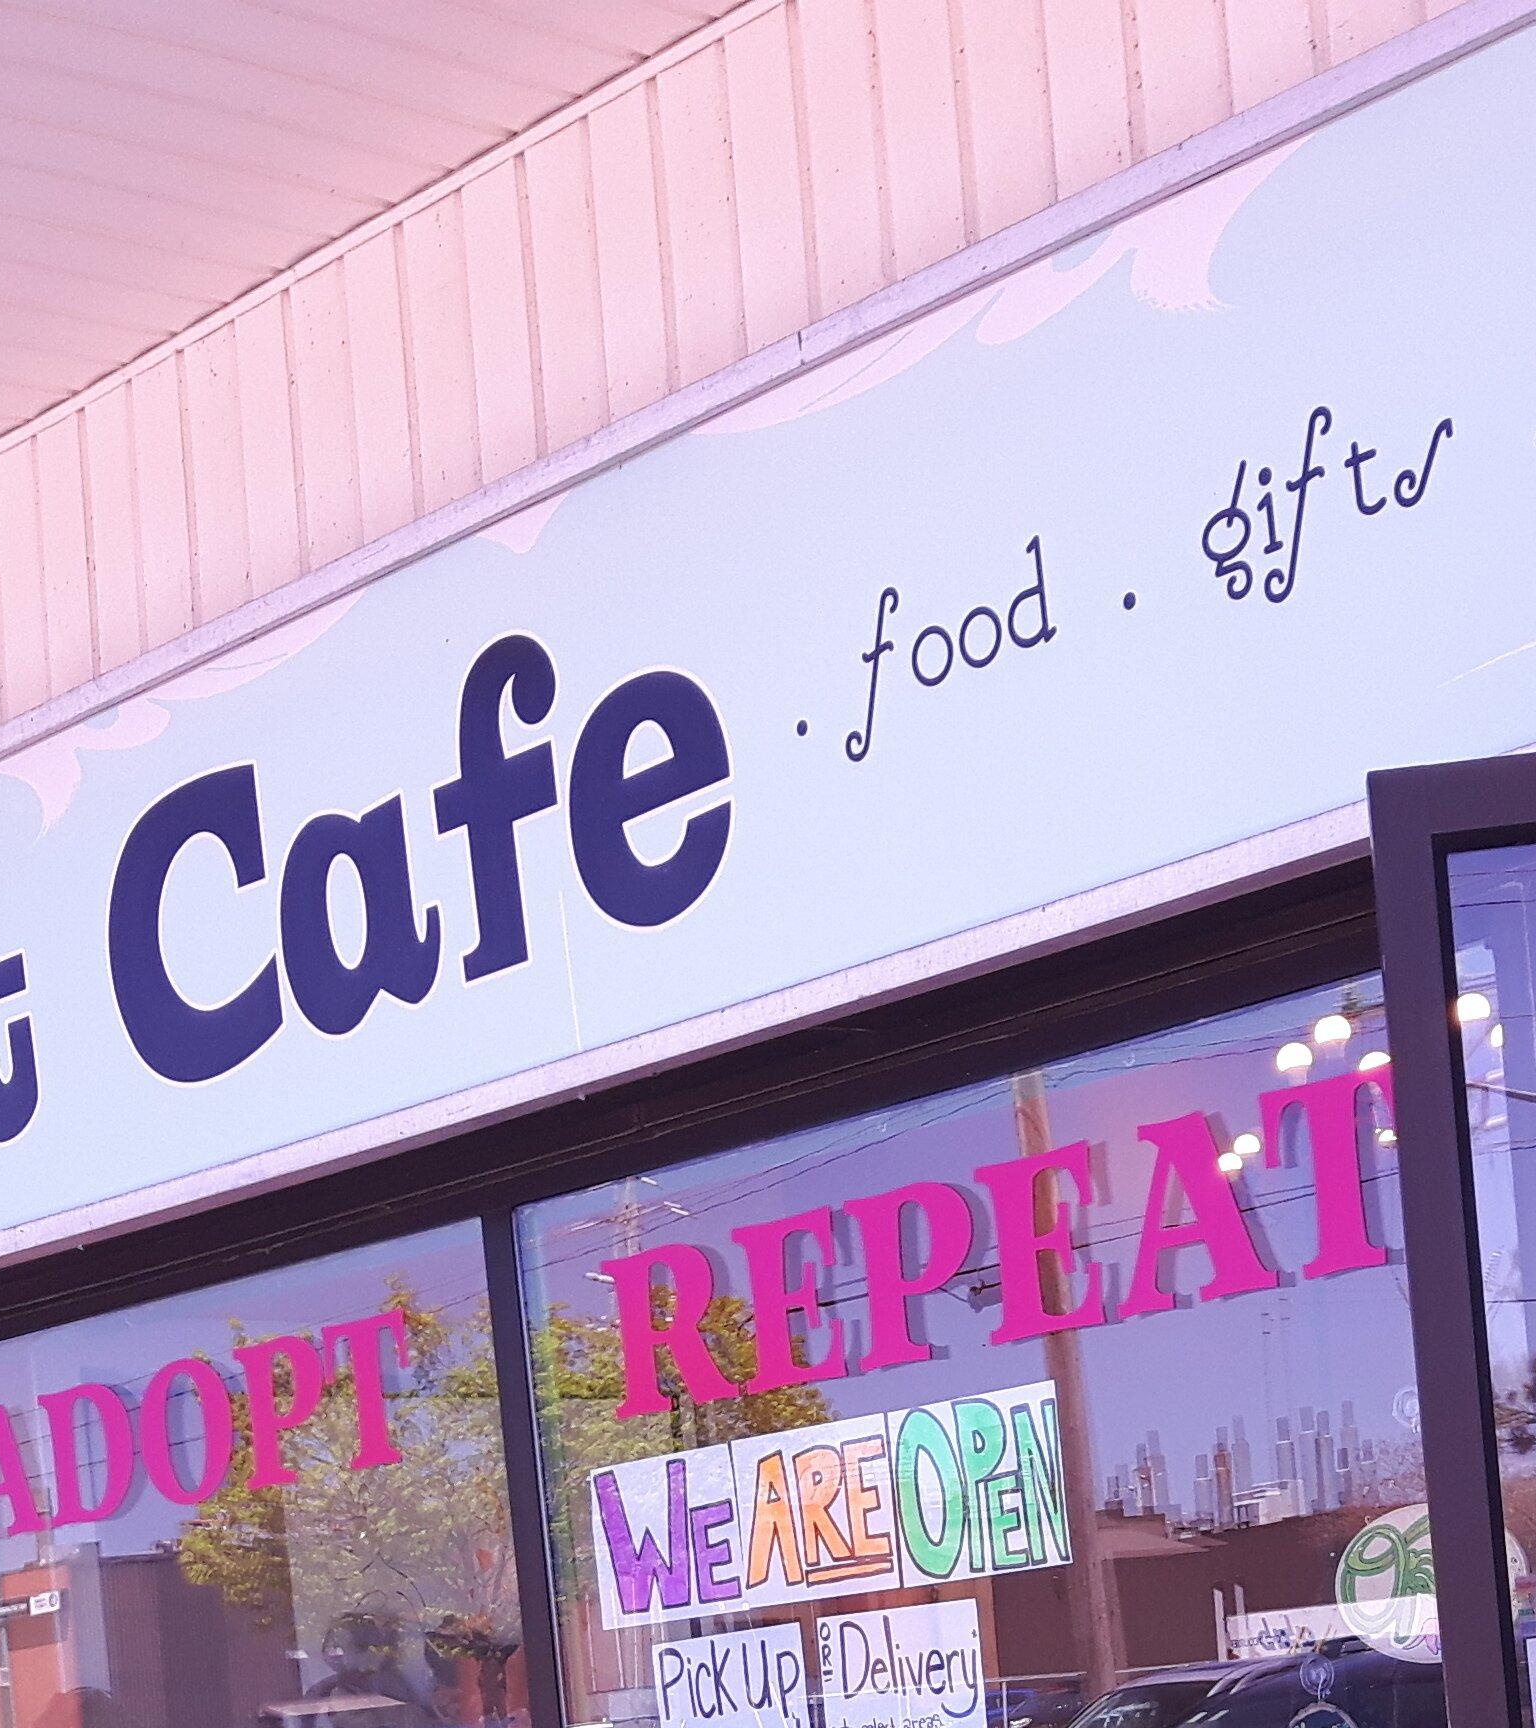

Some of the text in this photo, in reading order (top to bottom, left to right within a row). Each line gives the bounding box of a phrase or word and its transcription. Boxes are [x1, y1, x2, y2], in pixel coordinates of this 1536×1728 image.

[844, 405, 1454, 763] food gifts
[107, 628, 734, 1089] Cafe
[600, 1066, 1396, 1420] REPEAT
[746, 1435, 894, 1591] ARE
[894, 1398, 1072, 1580] OPEN
